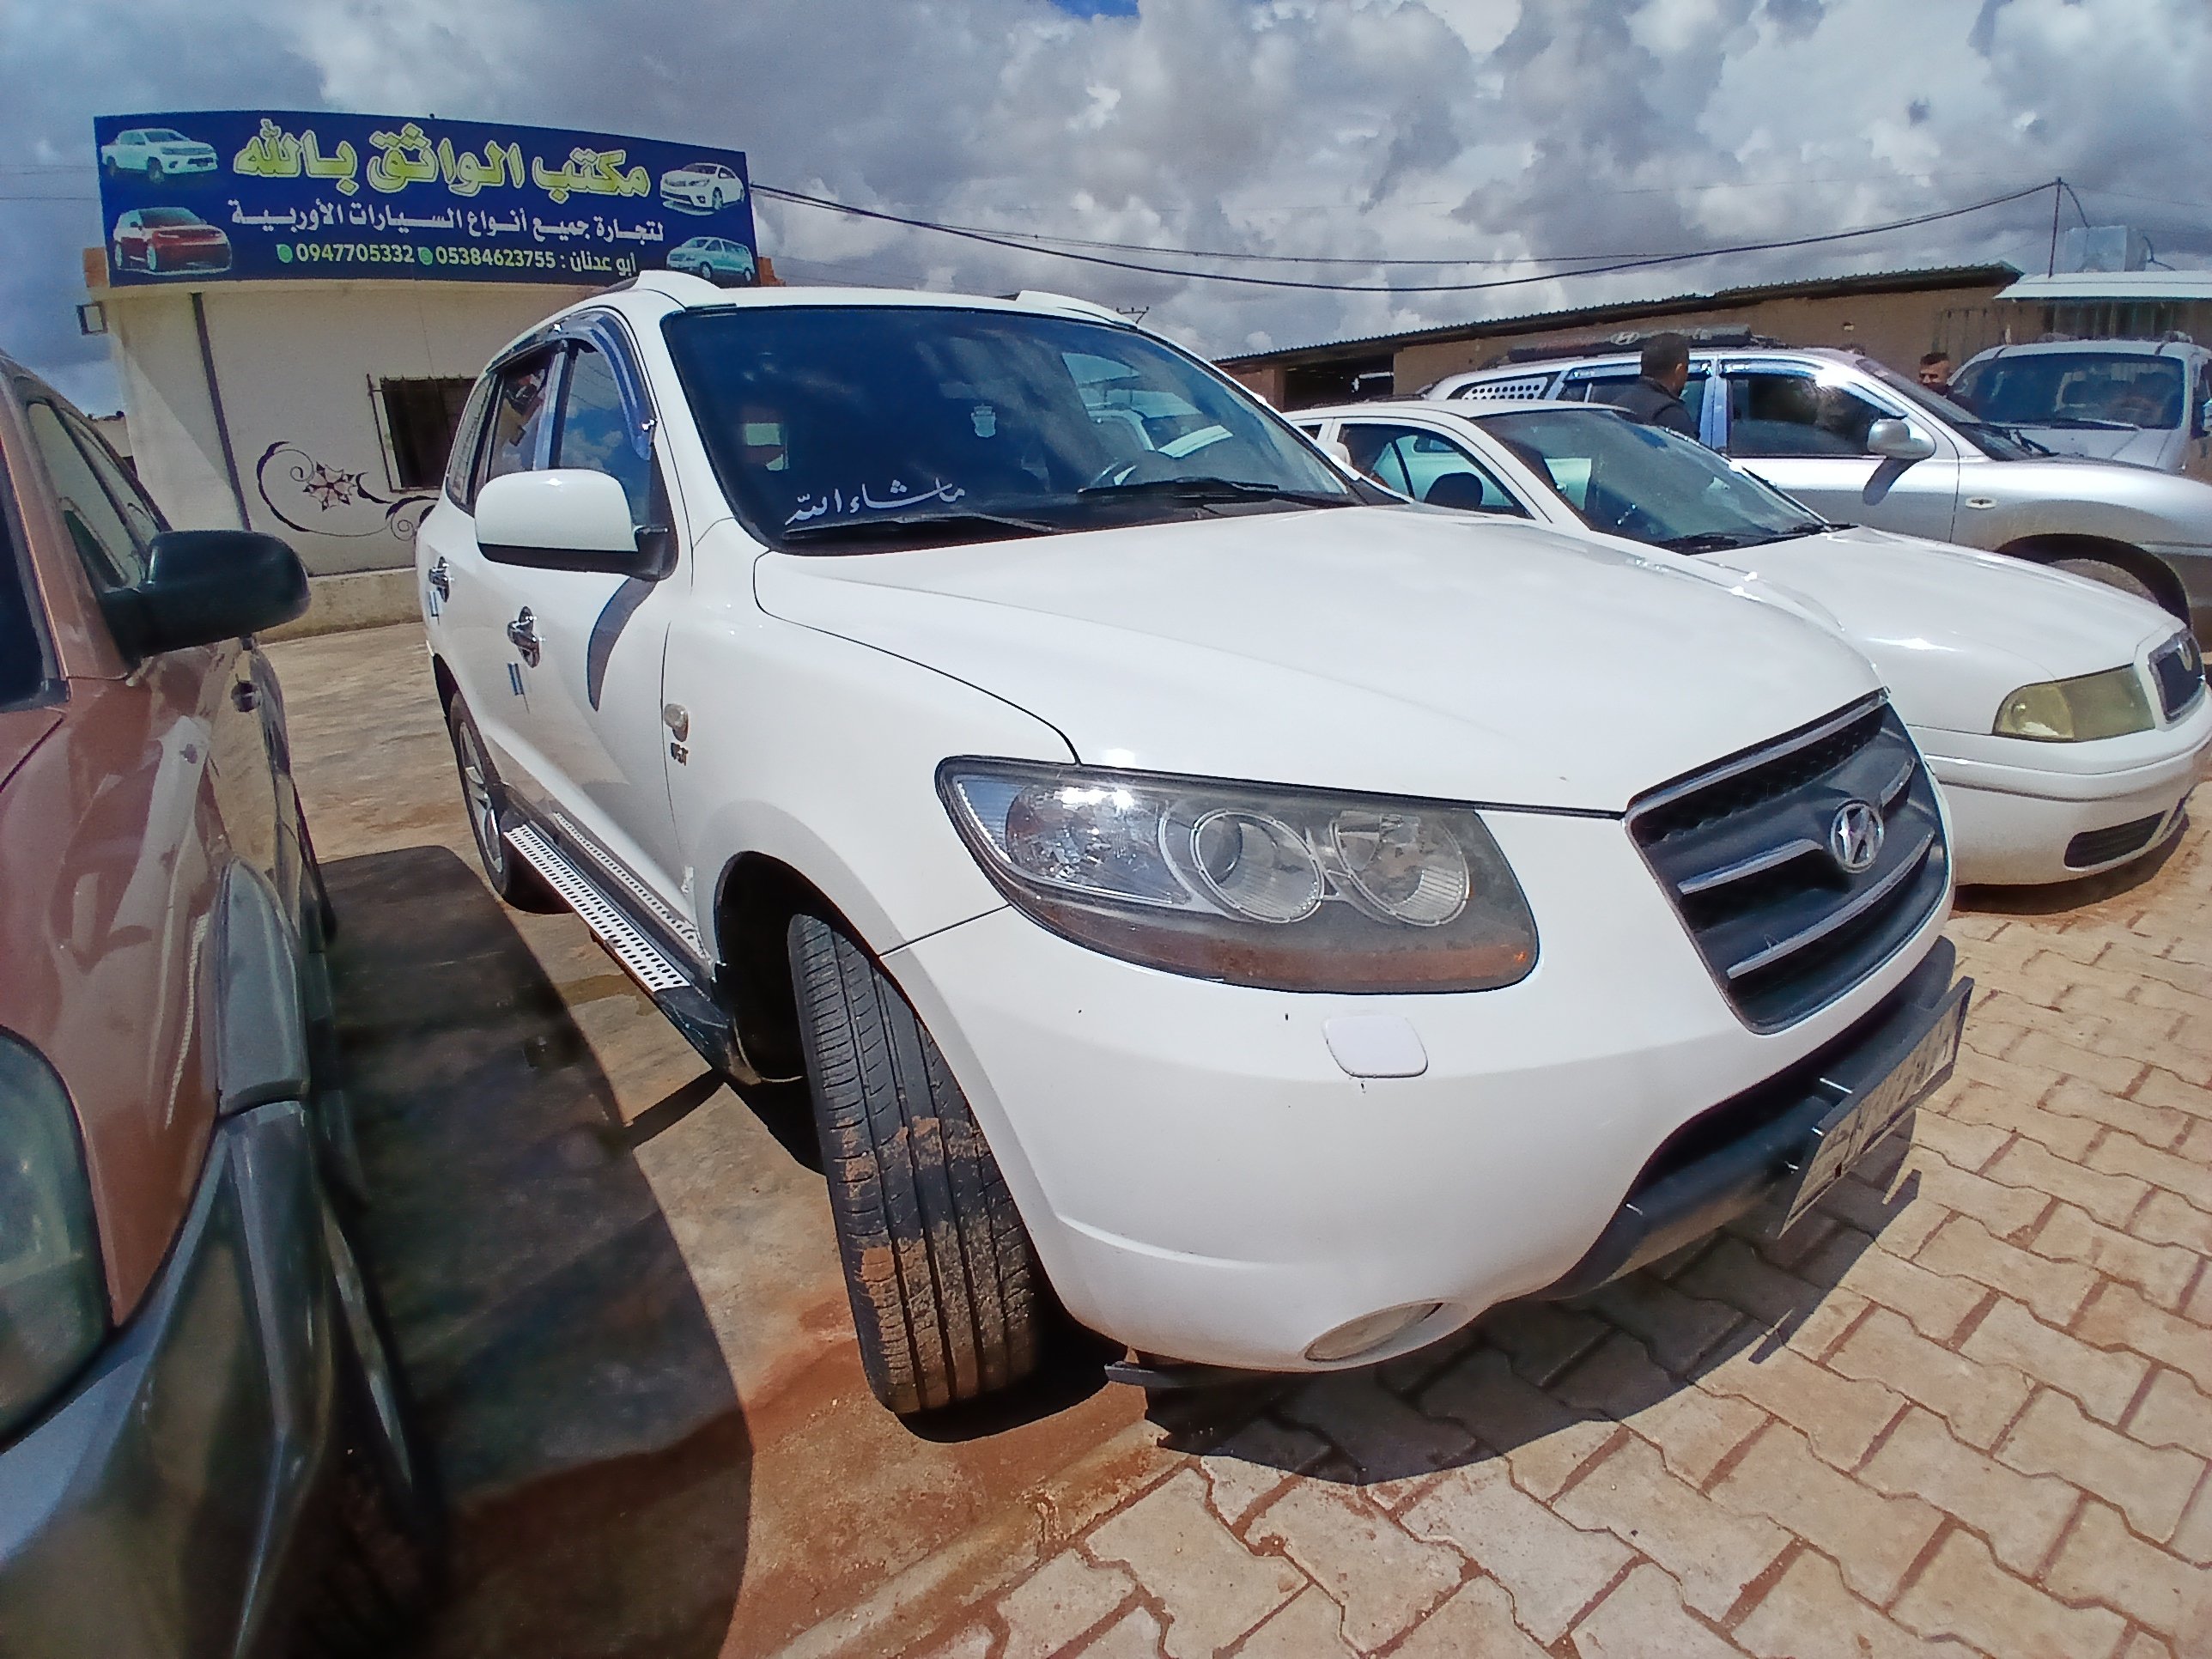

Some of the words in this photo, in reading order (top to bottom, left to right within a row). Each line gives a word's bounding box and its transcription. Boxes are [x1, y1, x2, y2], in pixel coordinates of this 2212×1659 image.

[233, 118, 360, 196] بالله
[367, 122, 526, 197] الواثق
[532, 147, 651, 204] مكتب
[228, 198, 343, 233] الأوربية
[349, 202, 463, 234] السيارات
[467, 208, 527, 237] أنواع
[532, 216, 590, 241] جميع
[592, 215, 664, 245] لتجارة
[295, 243, 416, 263] 0947705332
[435, 246, 556, 269] 05384623755
[569, 250, 612, 272] عدنان
[616, 252, 637, 276] أبو
[785, 489, 842, 526] الله
